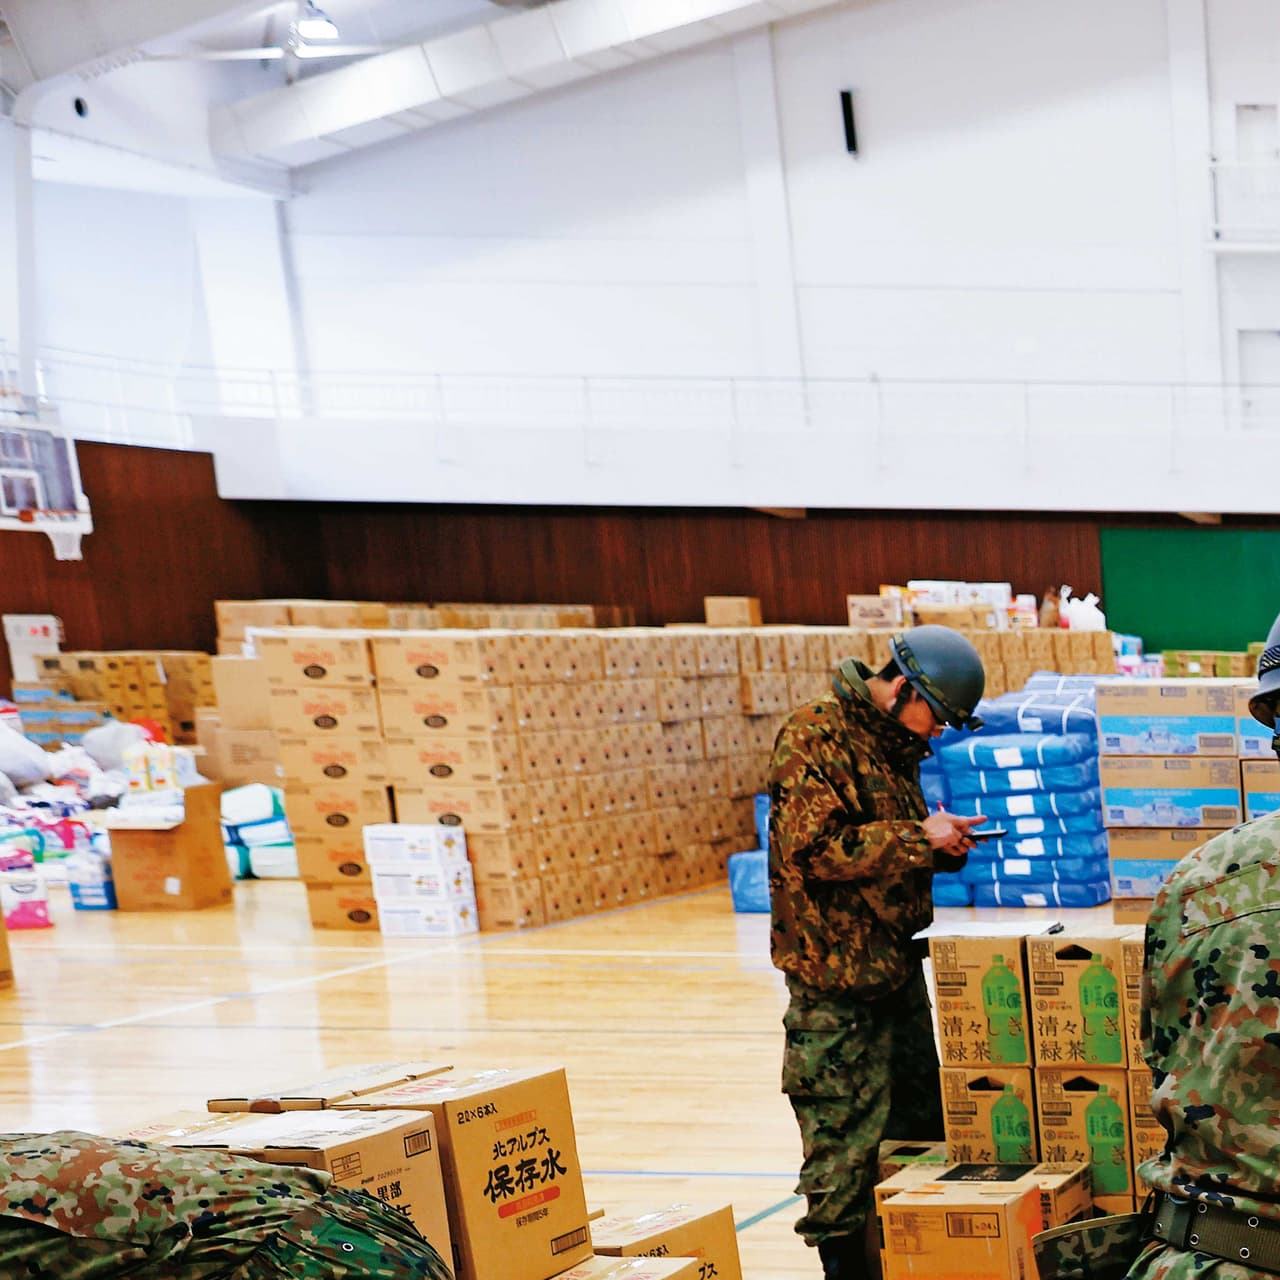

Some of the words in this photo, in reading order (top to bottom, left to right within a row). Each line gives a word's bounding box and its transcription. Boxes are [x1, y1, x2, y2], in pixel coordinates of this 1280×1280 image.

[492, 1126, 551, 1161] 北アルプス
[377, 1180, 403, 1202] 黒部
[483, 1148, 567, 1204] 保存水
